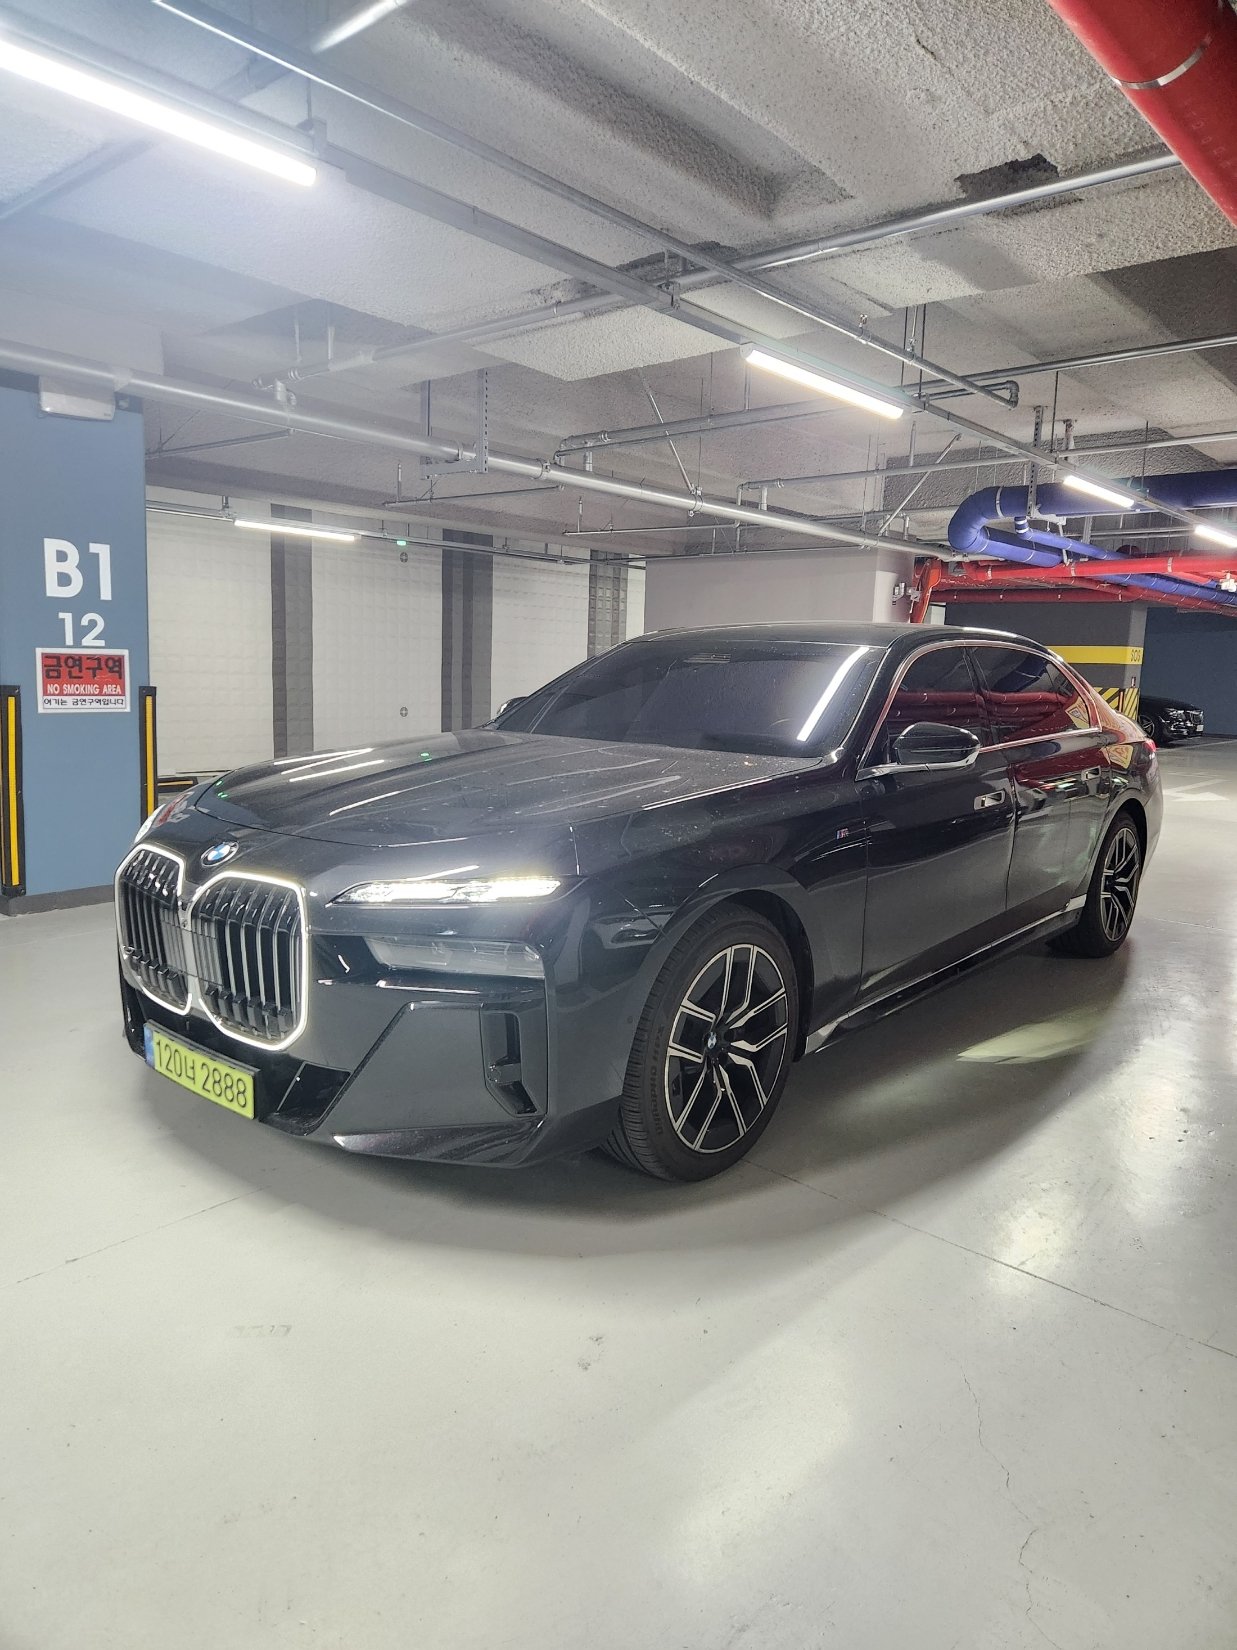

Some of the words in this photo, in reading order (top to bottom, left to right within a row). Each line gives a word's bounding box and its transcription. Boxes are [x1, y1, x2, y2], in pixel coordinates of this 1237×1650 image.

[43, 537, 112, 601] B1
[58, 612, 106, 647] 12
[43, 655, 123, 680] 금연구역
[47, 683, 60, 695] NO
[63, 683, 100, 695] SMOKING
[102, 684, 122, 695] AREA
[72, 698, 124, 706] 금연구역입니다
[156, 1039, 197, 1085] 120너
[200, 1062, 247, 1109] 2888
